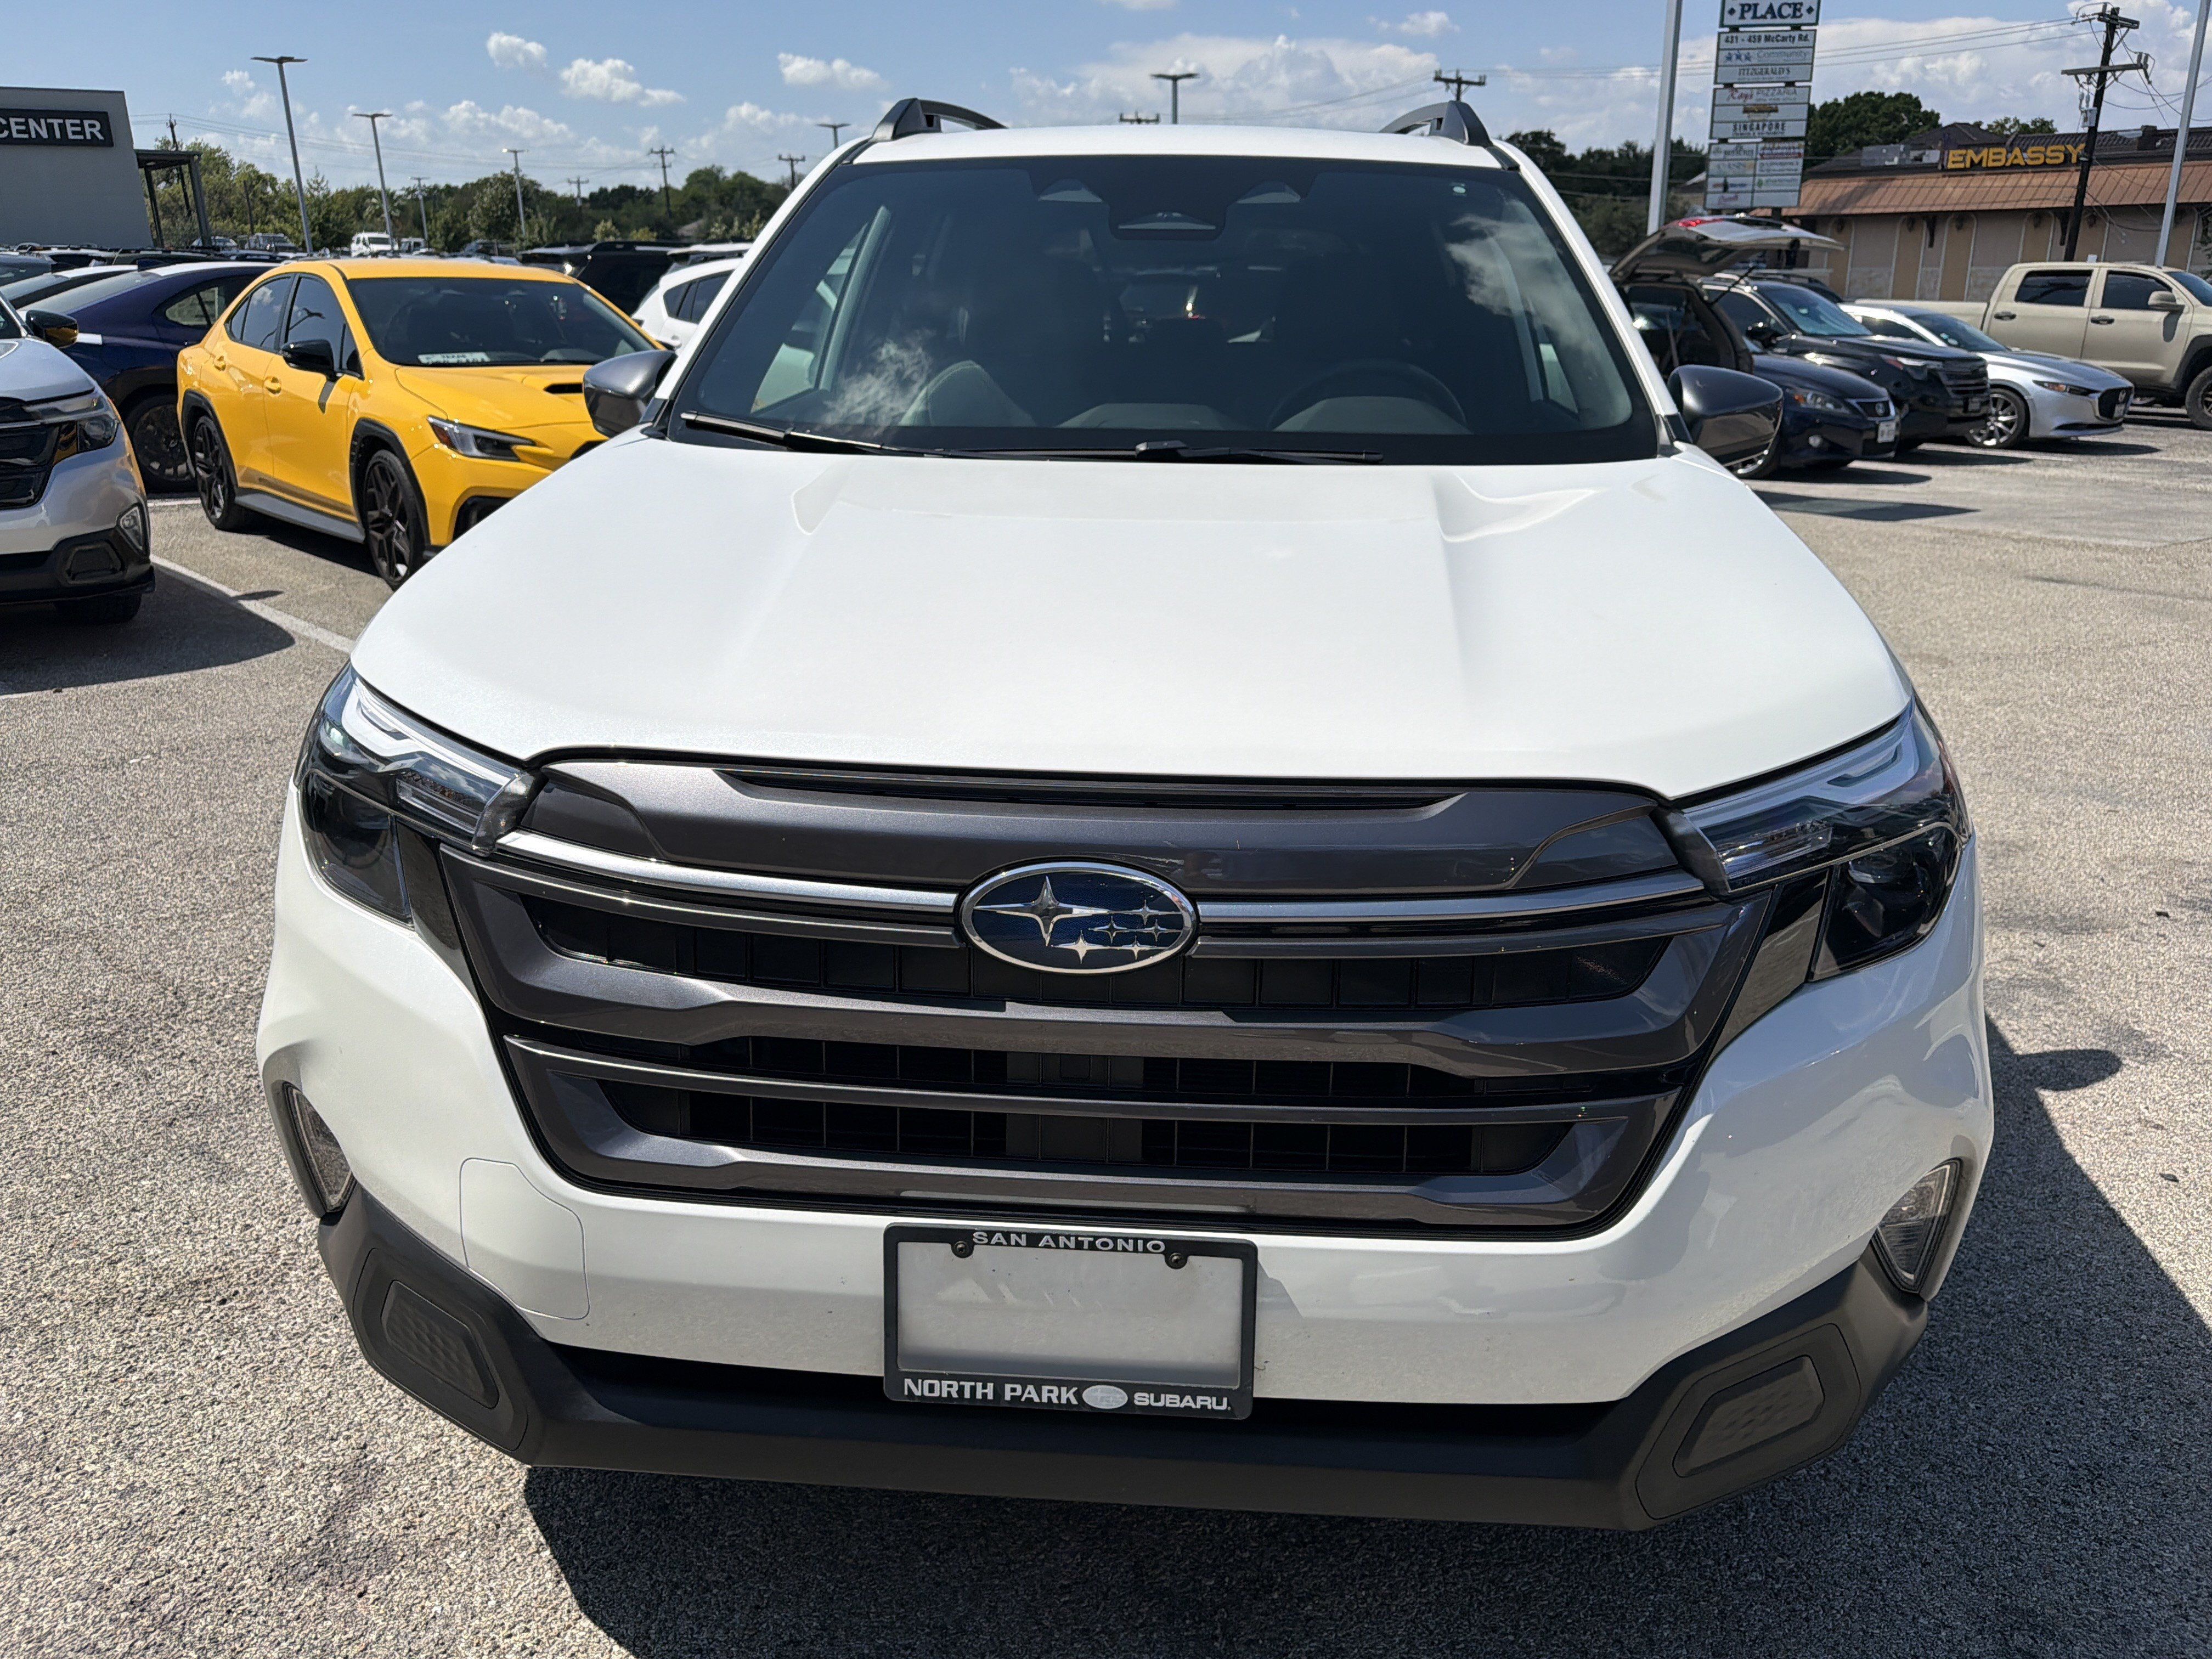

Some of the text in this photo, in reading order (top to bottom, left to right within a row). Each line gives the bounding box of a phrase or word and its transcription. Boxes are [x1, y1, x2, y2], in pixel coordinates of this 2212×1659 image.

[1739, 2, 1804, 20] PLACE
[1764, 33, 1796, 44] McCarty
[1756, 50, 1809, 59] Community
[0, 116, 105, 140] CENTER
[1732, 122, 1786, 132] SINGAPORE
[1947, 143, 2086, 170] EMBASSY
[973, 1232, 1166, 1254] SAN ANTONIO
[903, 1378, 995, 1401] NORTH
[1003, 1383, 1079, 1406] PARK
